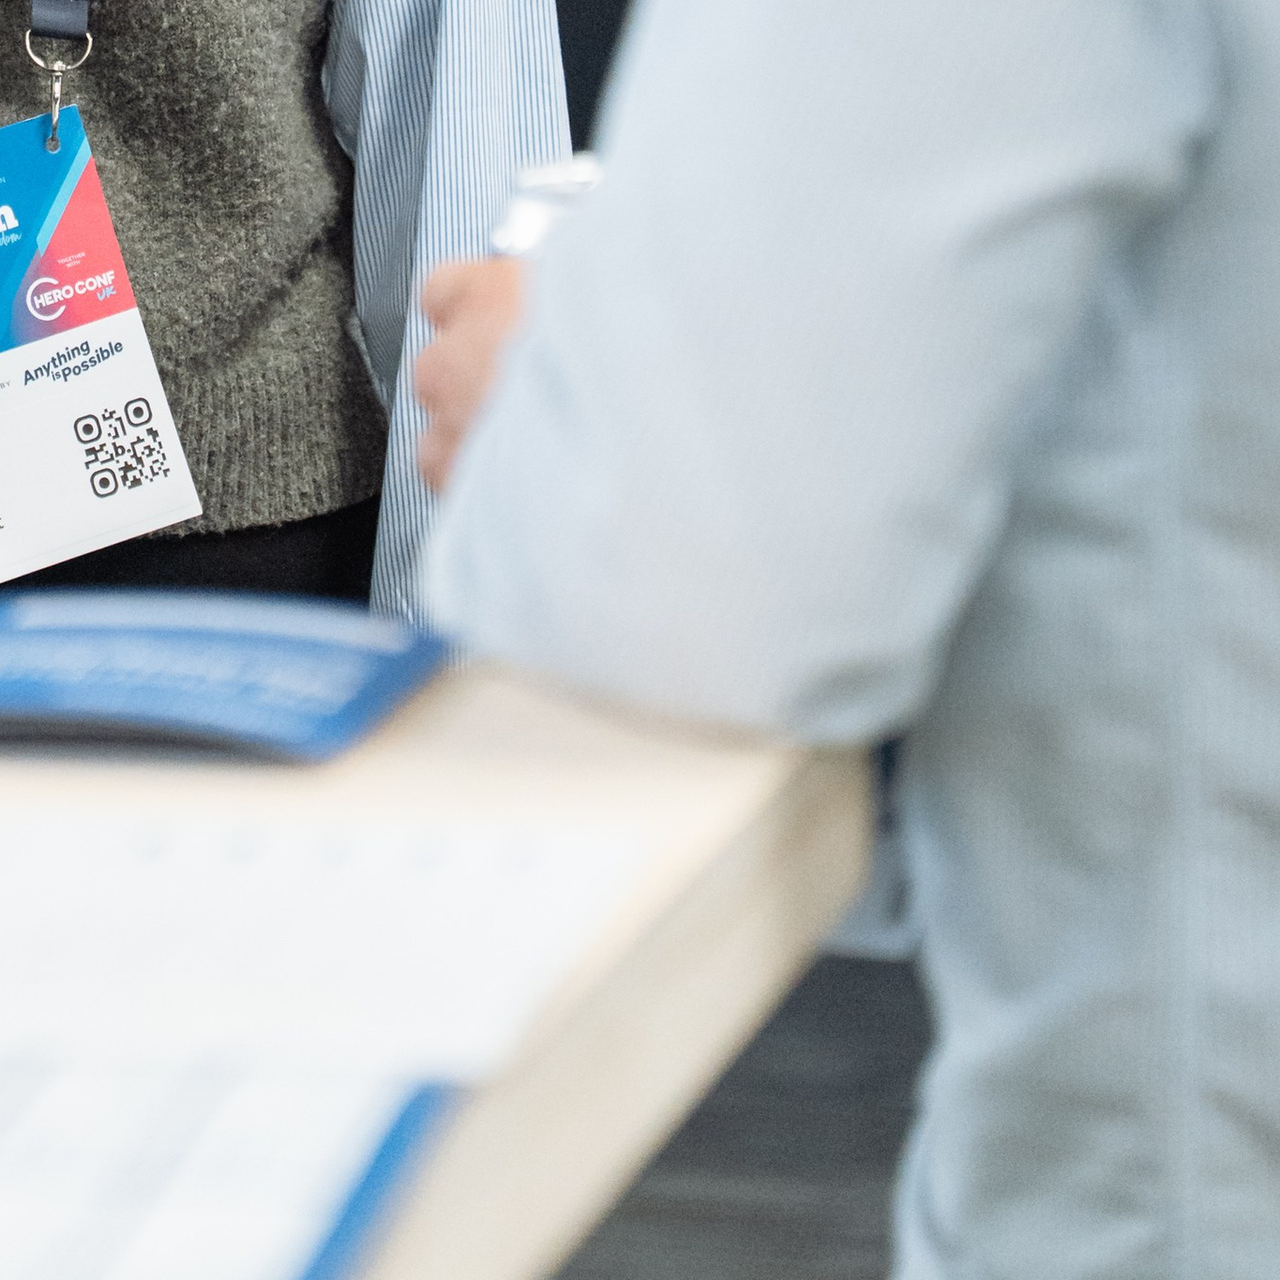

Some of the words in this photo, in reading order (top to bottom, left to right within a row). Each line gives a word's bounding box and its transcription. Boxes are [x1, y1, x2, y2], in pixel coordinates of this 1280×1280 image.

[57, 251, 86, 265] TOGETHER
[66, 260, 81, 269] WITH
[33, 284, 75, 310] HERO
[74, 270, 116, 295] CONF
[96, 285, 117, 302] UK
[23, 340, 91, 387] Anything
[51, 369, 62, 382] is
[0, 380, 12, 391] BY
